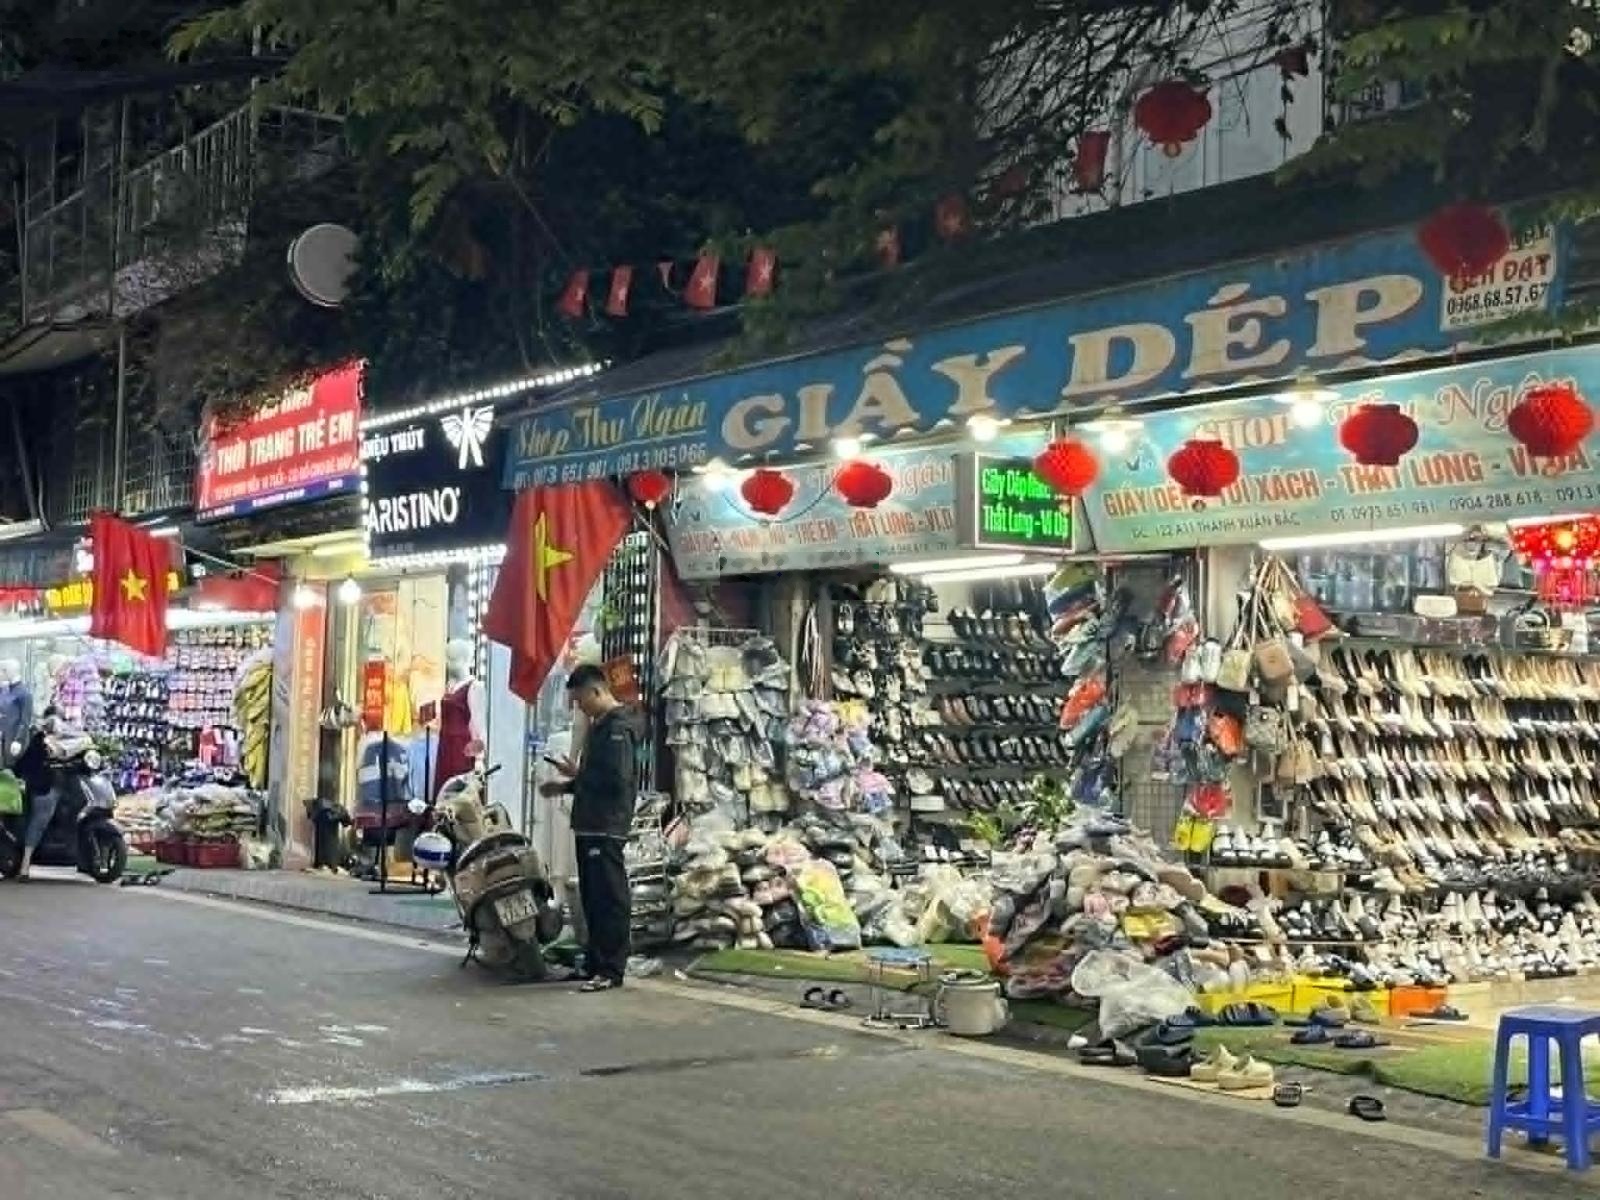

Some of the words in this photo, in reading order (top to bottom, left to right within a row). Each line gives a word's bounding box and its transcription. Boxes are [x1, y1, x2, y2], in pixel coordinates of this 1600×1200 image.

[721, 341, 1025, 450] GIẦY
[1062, 275, 1424, 398] DÉP
[217, 437, 246, 475] THỜI
[250, 427, 295, 465] TRANG
[298, 409, 325, 453] TRẺ
[328, 410, 354, 445] EM
[572, 406, 625, 448] Thu
